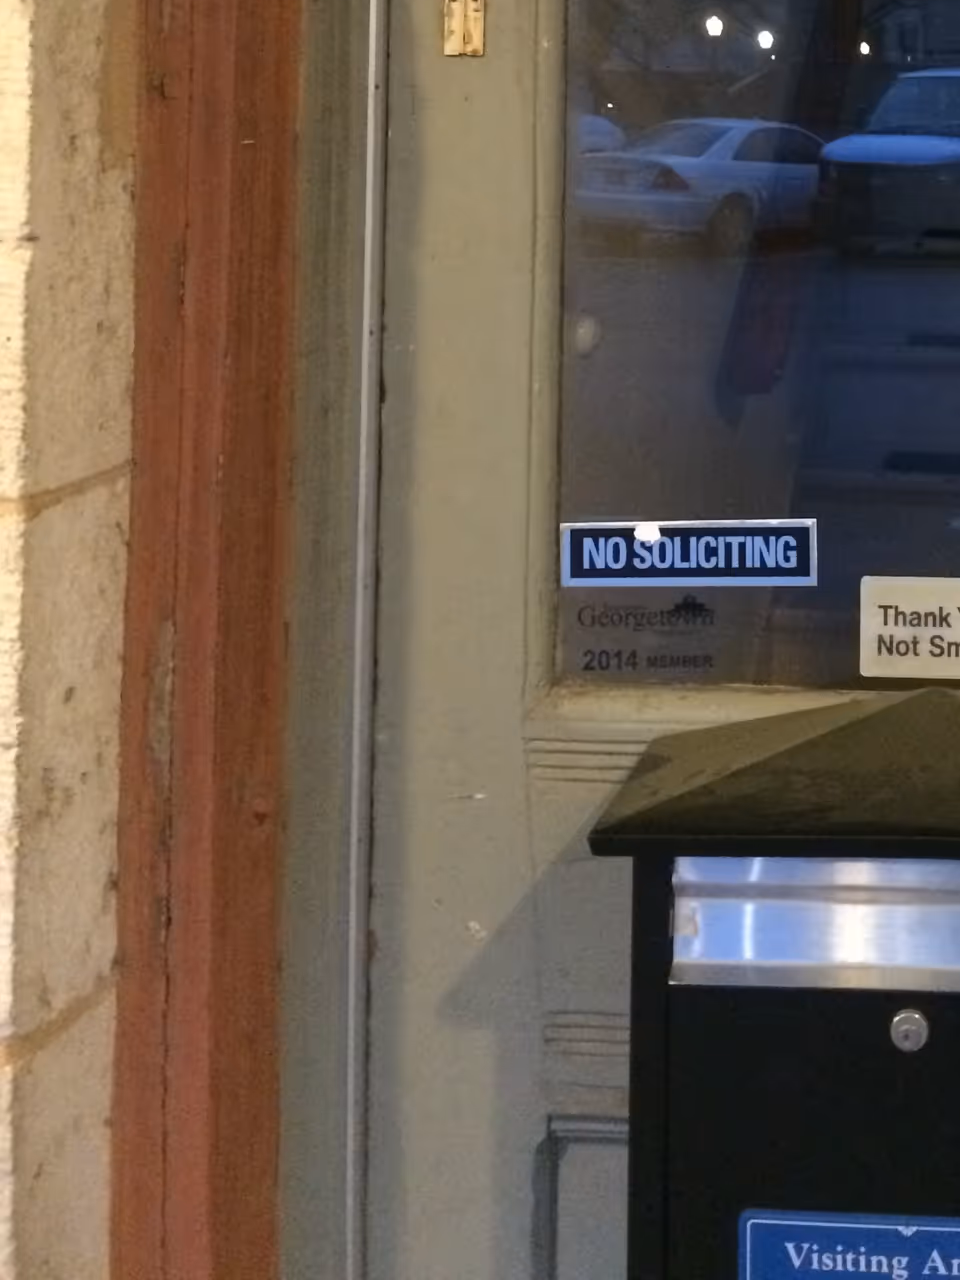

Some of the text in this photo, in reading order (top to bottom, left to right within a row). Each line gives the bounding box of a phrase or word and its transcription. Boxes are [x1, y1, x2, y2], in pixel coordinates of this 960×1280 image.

[582, 534, 798, 569] NO SOLICITING
[577, 604, 715, 632] Georgetown
[877, 603, 952, 631] Thank
[876, 633, 921, 658] Not
[582, 649, 714, 671] 2014 MEMBER
[784, 1241, 909, 1280] Visiting
